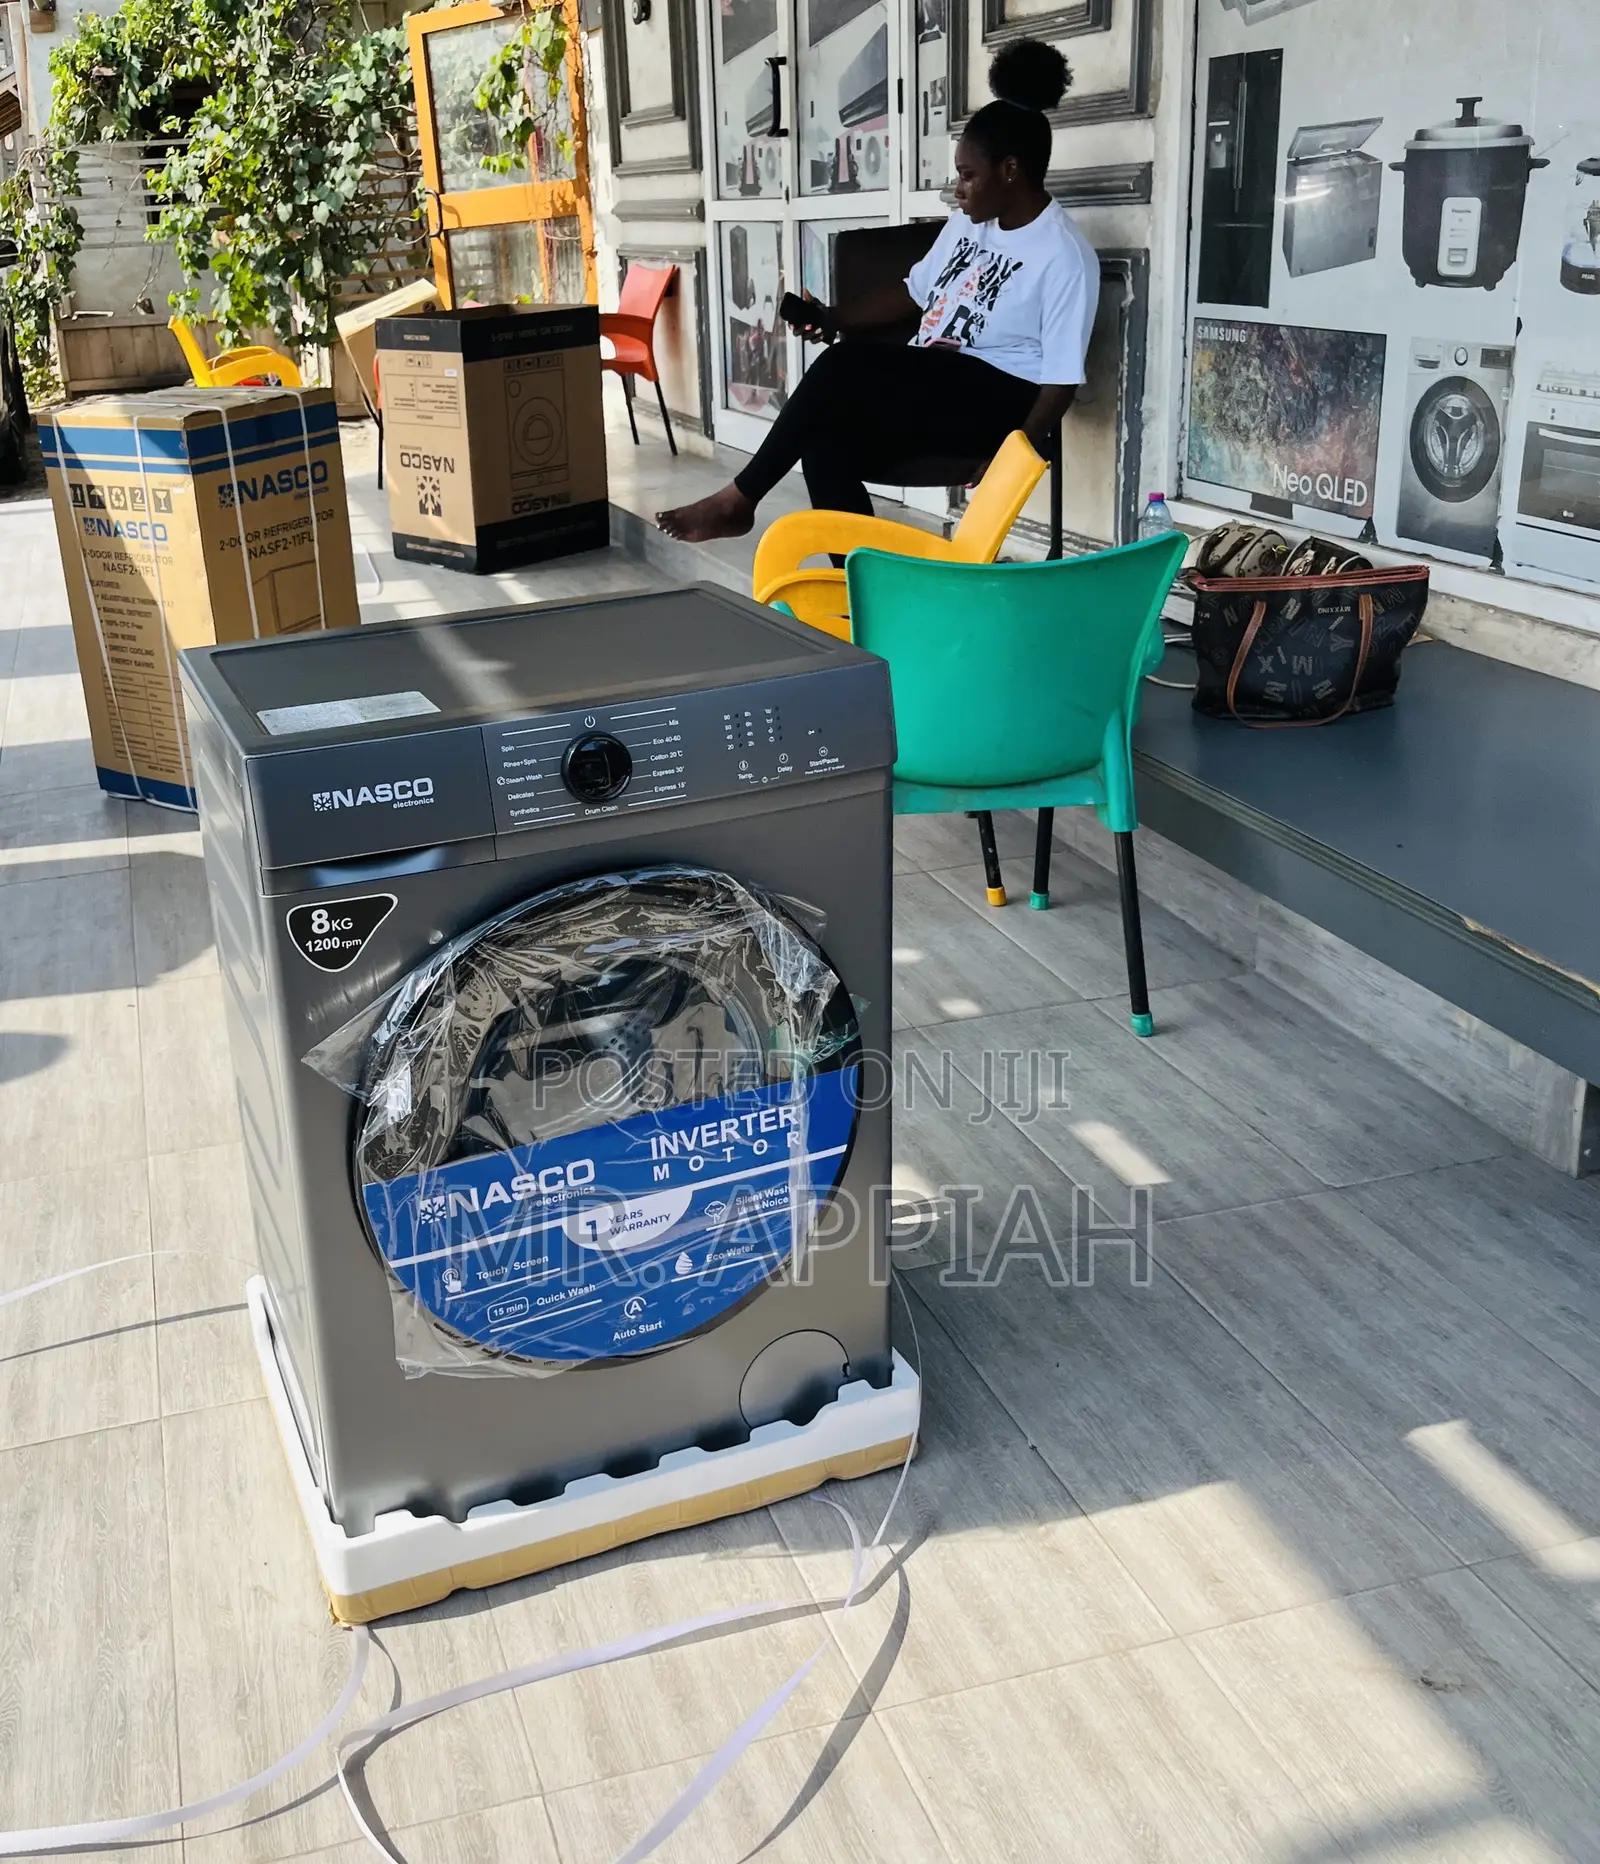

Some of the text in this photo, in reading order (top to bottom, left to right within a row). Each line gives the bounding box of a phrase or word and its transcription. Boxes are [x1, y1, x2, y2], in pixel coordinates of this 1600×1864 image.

[1197, 324, 1246, 342] SAMSUNG
[400, 452, 455, 474] NASCO
[237, 460, 328, 504] NASCO
[1273, 463, 1368, 507] Neo QLED
[96, 518, 168, 541] NASCO
[114, 551, 173, 566] REFRGERTOR
[501, 745, 515, 753] Spin
[650, 753, 669, 761] Cotton
[503, 758, 537, 768] Rinse+Spin
[652, 767, 675, 777] Express
[505, 773, 543, 784] Steam Wash
[332, 777, 434, 809] NASCO
[508, 791, 535, 800] Delicates
[654, 783, 677, 793] Express
[392, 797, 435, 809] electronics
[510, 807, 540, 817] Synthetics
[584, 807, 601, 815] Drum
[650, 1105, 799, 1161] INVERTER
[448, 1158, 596, 1218] NASCO
[536, 1184, 596, 1208] electronics
[735, 1185, 790, 1206] Silent Wash
[608, 1209, 643, 1225] YEARS
[609, 1213, 672, 1236] WARRANTY
[585, 1219, 598, 1242] 1
[706, 1244, 755, 1262] Eco Water
[476, 1255, 549, 1281] Touch Screen
[536, 1284, 596, 1306] Quick Wash
[493, 1302, 524, 1317] 15 min
[612, 1320, 663, 1342] Auto Start
